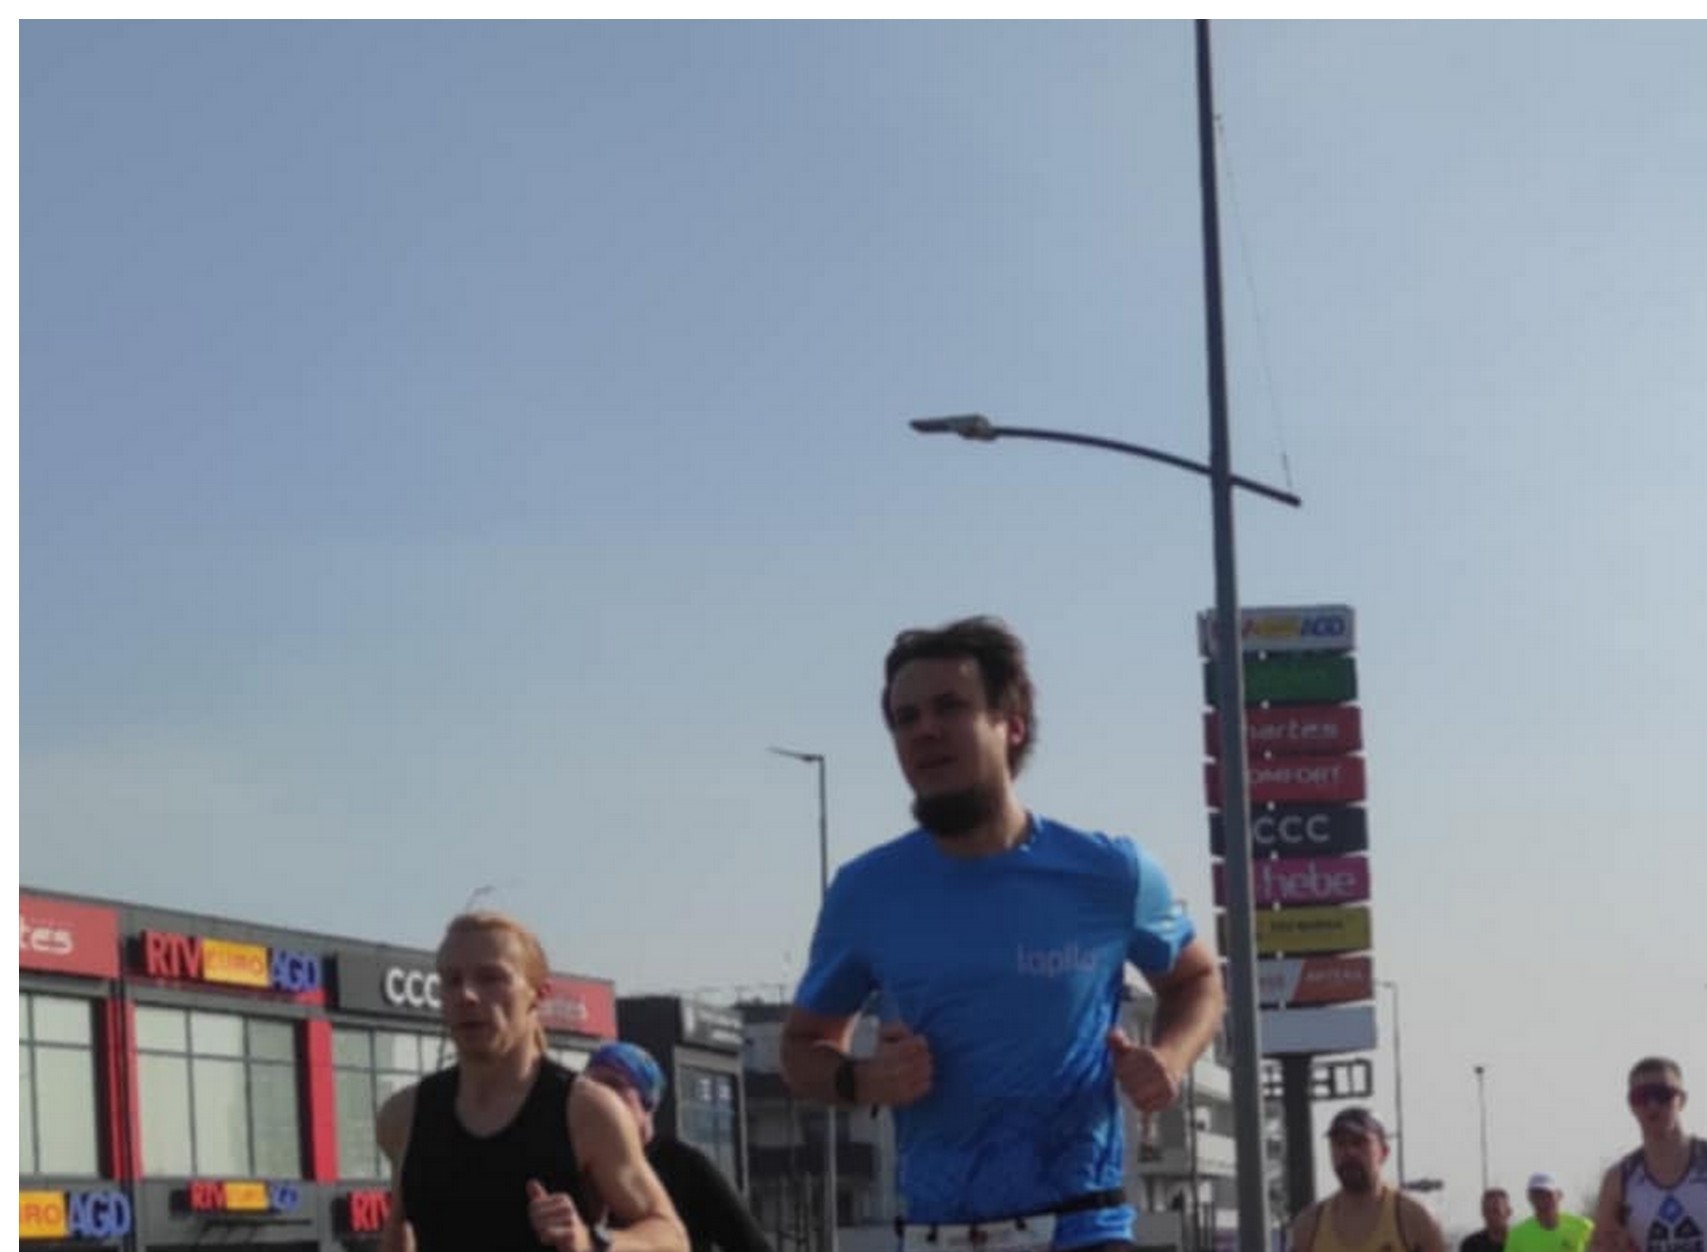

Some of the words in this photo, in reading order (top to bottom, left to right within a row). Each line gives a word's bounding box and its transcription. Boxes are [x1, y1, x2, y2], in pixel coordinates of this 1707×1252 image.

[1254, 814, 1330, 843] CCC
[1262, 861, 1356, 900] hebe
[145, 930, 204, 979] RTV
[69, 1190, 131, 1238] AGD
